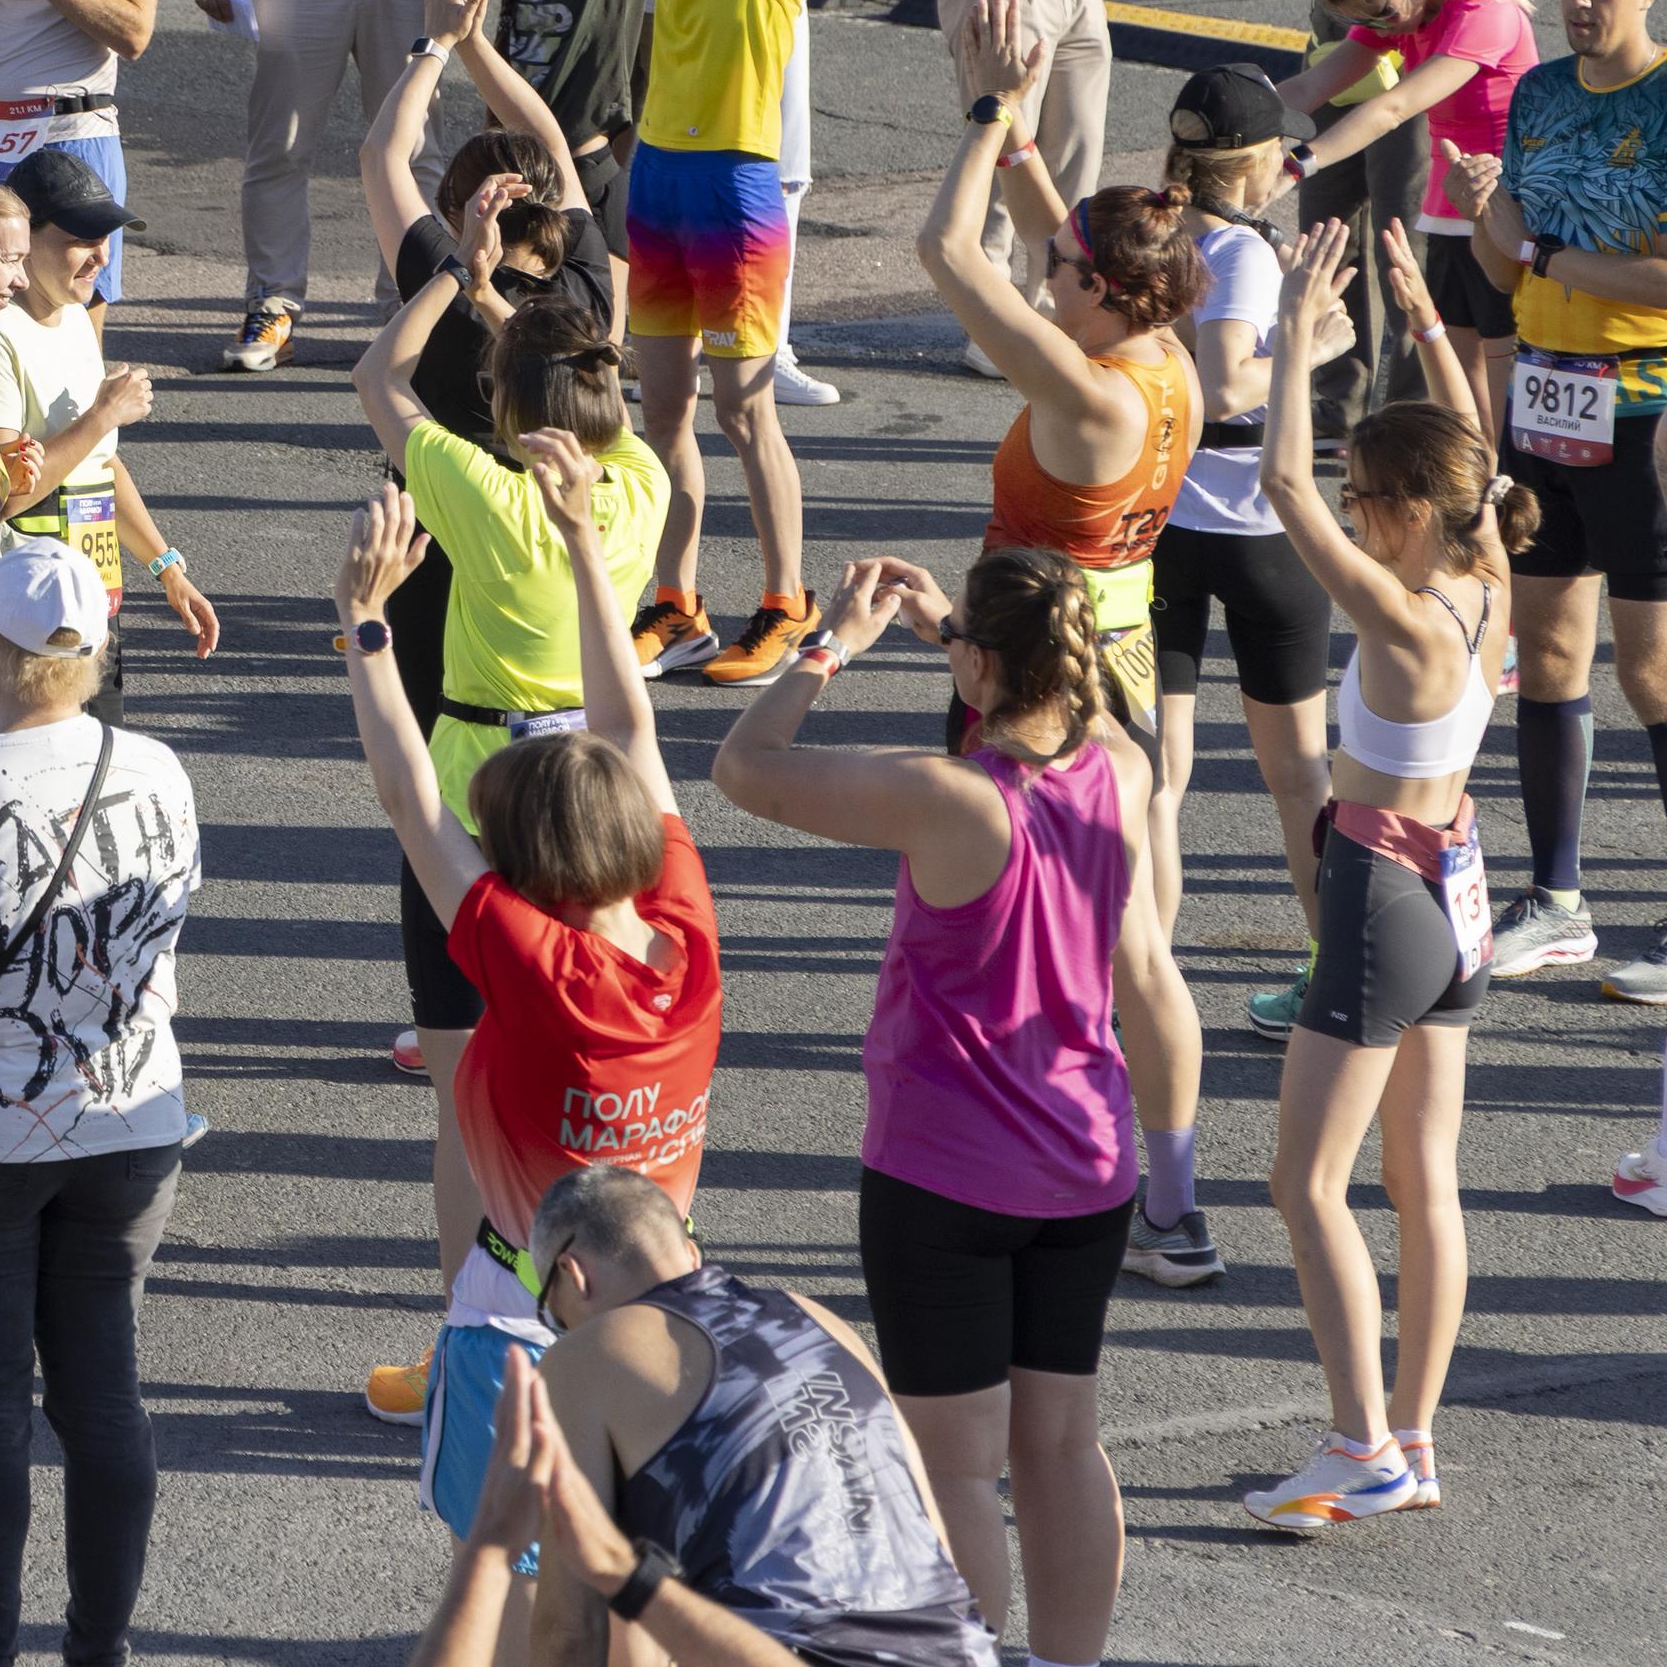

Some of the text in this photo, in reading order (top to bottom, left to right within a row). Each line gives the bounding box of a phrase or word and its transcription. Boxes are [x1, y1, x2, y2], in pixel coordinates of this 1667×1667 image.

[1525, 374, 1599, 422] 9812
[1536, 413, 1581, 431] ВАСИЛИЙ
[1122, 505, 1170, 538] T20
[564, 1082, 662, 1122] ПОЛУ
